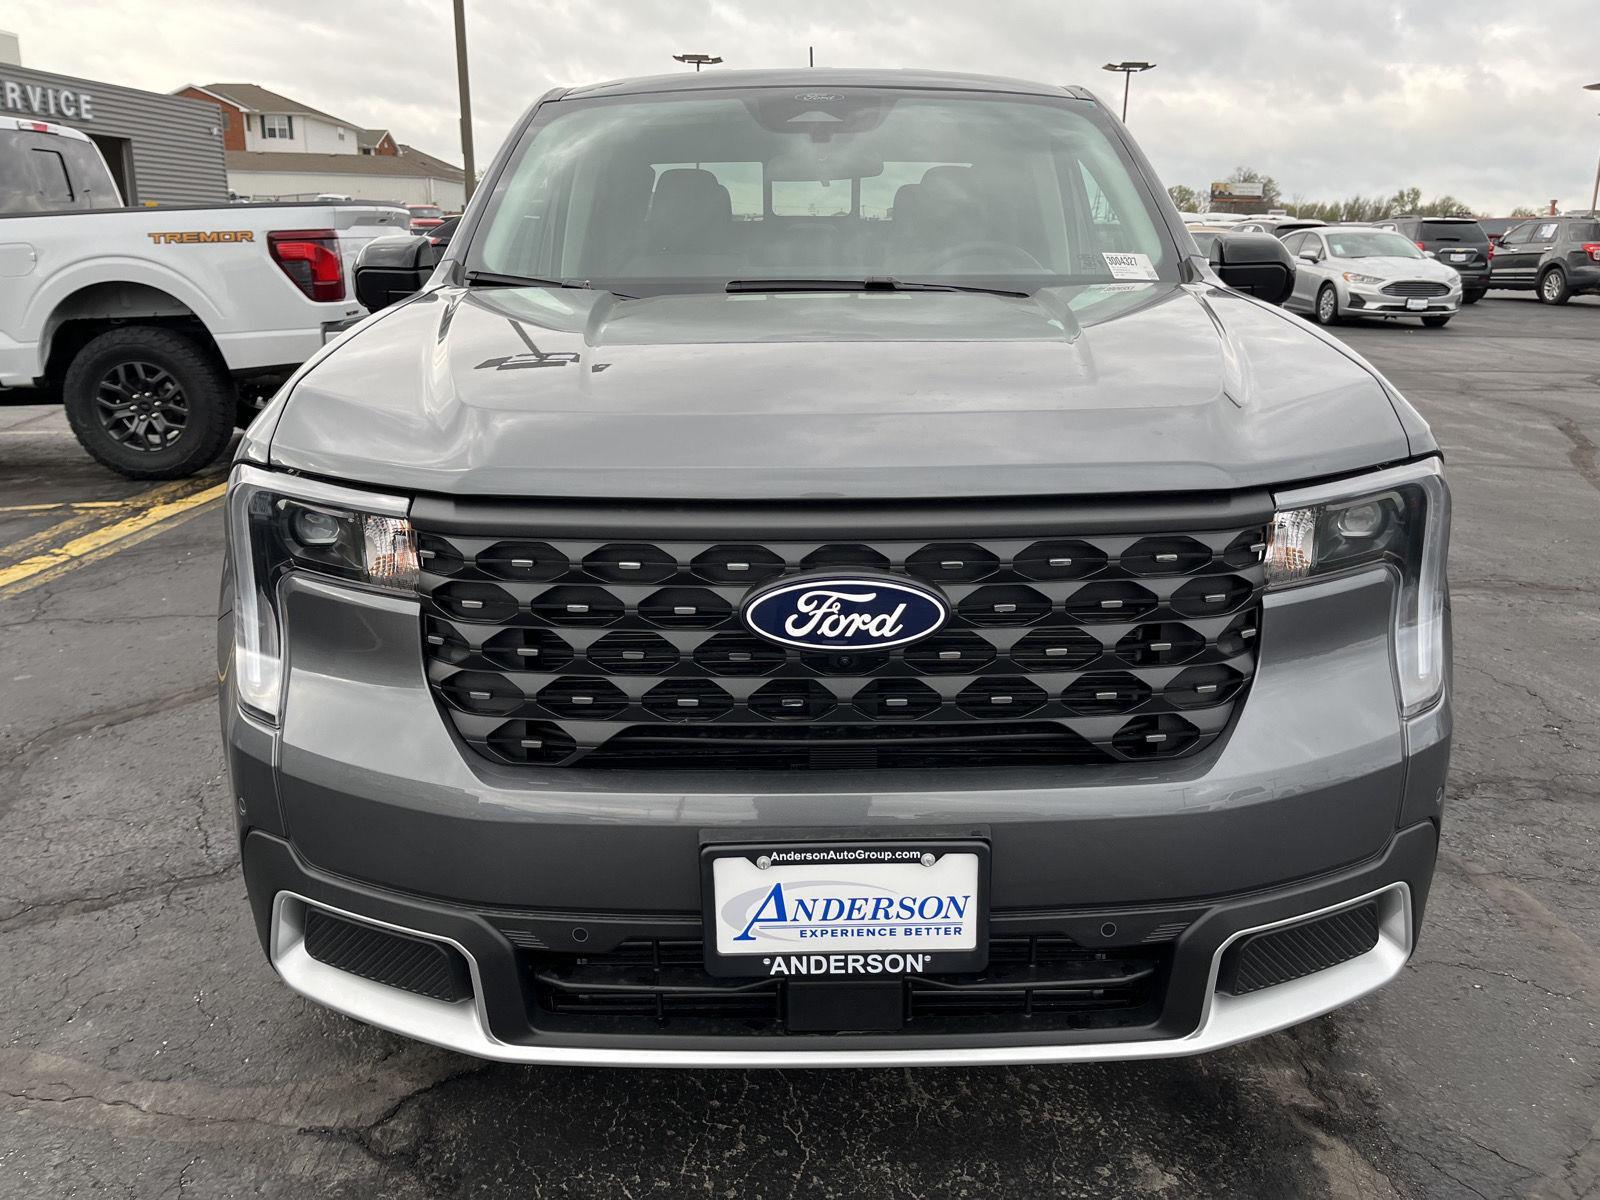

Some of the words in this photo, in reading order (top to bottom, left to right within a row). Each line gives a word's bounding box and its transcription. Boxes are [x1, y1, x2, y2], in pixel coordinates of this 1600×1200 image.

[5, 81, 94, 119] RVICE
[147, 230, 256, 245] TREMOR
[1106, 256, 1138, 267] 3004327
[784, 590, 908, 638] Ford
[770, 849, 921, 861] AndersonAutoGroup.com
[732, 882, 971, 941] ANDERSON
[799, 927, 897, 938] EXPERIENCE
[903, 926, 963, 937] BETTER
[769, 953, 924, 976] ANDERSON
